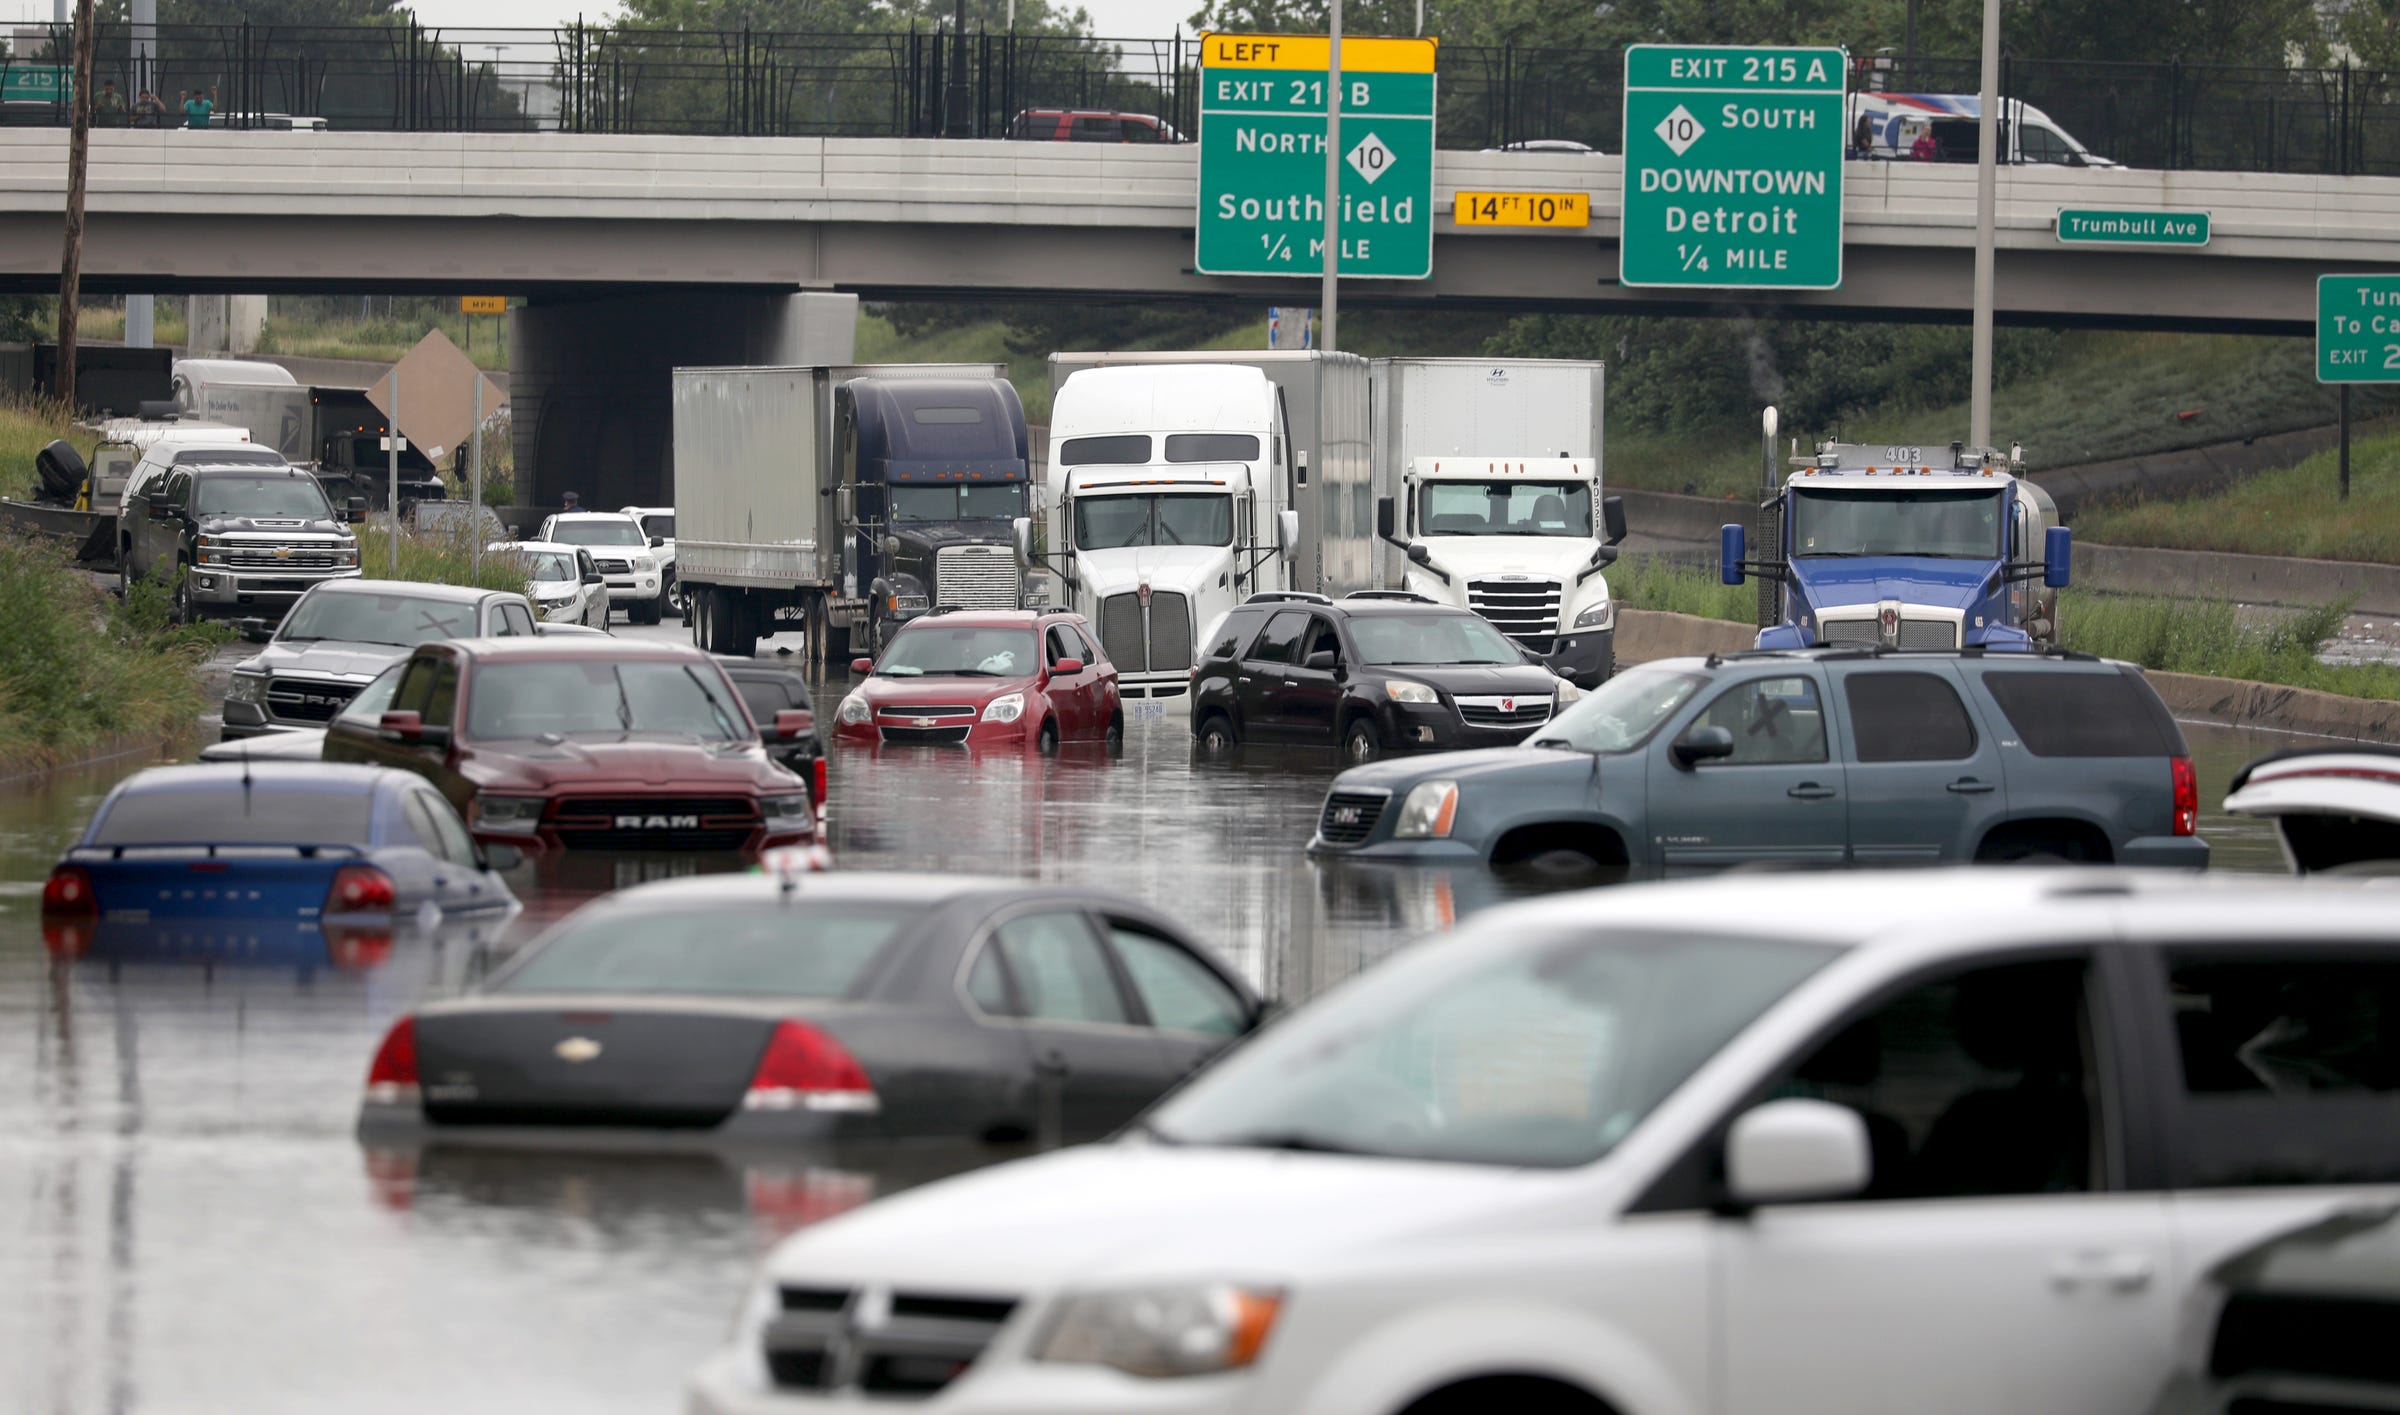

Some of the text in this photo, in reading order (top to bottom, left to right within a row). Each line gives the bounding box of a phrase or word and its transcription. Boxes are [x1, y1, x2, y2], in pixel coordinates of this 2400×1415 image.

[1220, 43, 1281, 62] LEFT
[18, 69, 53, 86] 215
[1670, 57, 1828, 83] EXIT 215 A
[1217, 81, 1274, 102] EXIT
[1351, 81, 1370, 106] B
[1721, 103, 1816, 130] SOUTH
[1235, 128, 1328, 155] NORTH
[1667, 118, 1694, 142] 10
[1358, 146, 1384, 169] 10
[1640, 168, 1826, 196] DOWNTOWN
[1218, 193, 1413, 224] Southield
[1665, 206, 1799, 235] Detroit
[2071, 216, 2198, 236] Trumbull Ave
[1309, 238, 1370, 260] MLE
[1677, 243, 1788, 272] 1/4 MILE
[472, 300, 495, 309] MPH
[2357, 287, 2400, 307] Tun
[2333, 315, 2400, 334] To Ca
[2330, 343, 2400, 369] EXIT 2
[1885, 446, 1922, 463] 403
[306, 694, 352, 707] RA
[614, 815, 699, 829] RAM
